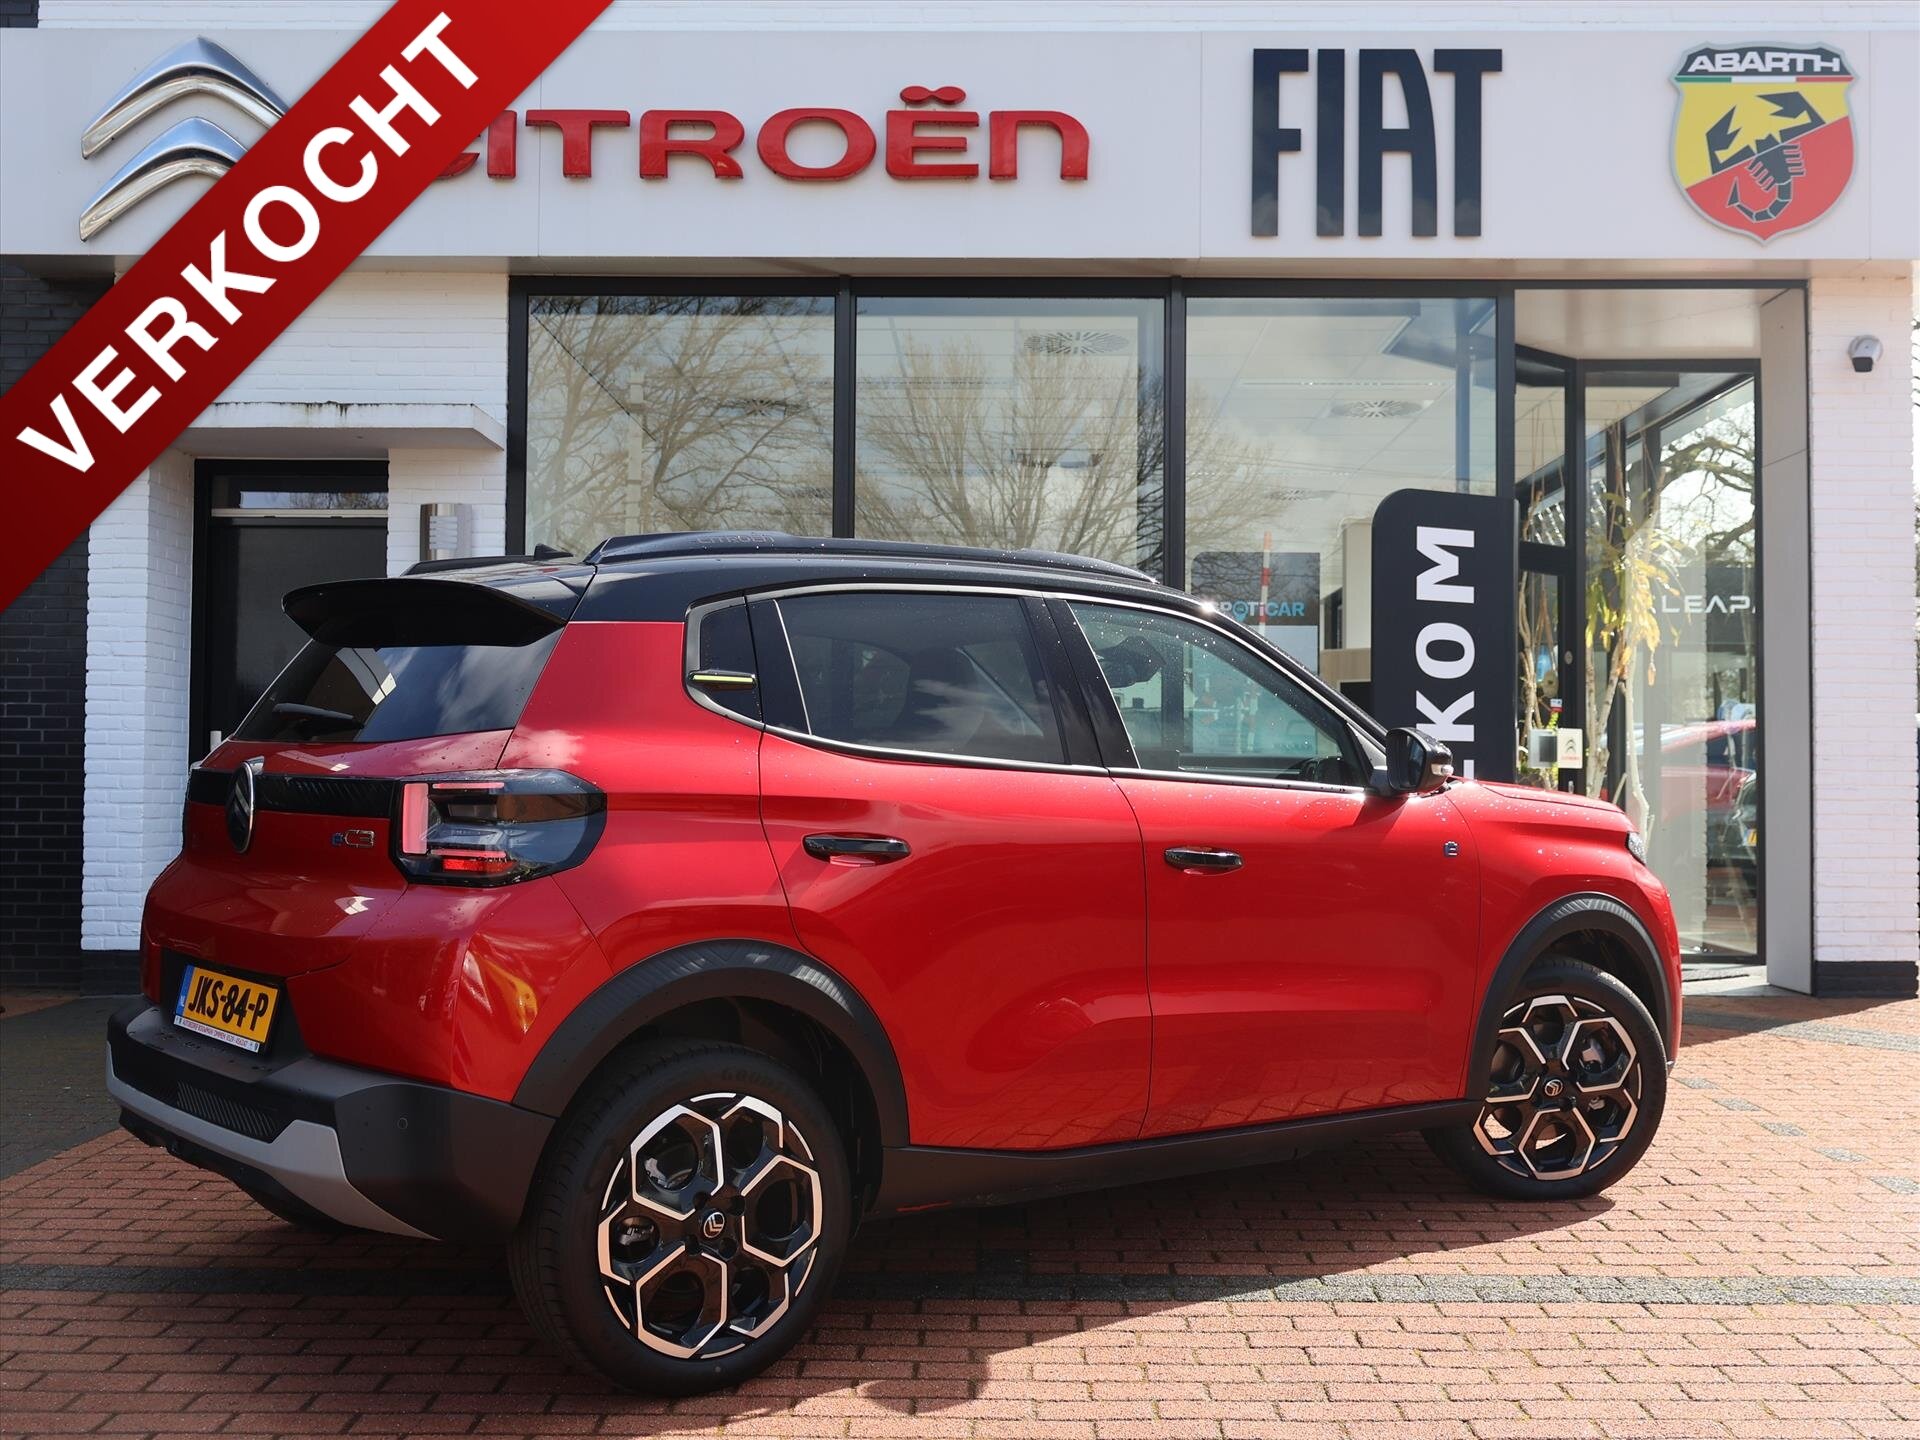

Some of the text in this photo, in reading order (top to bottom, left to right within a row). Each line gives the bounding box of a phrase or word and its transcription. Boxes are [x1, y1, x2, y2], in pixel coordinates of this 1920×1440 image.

[1686, 50, 1841, 73] ABARTH
[1251, 48, 1503, 237] FIAT
[1661, 594, 1756, 614] LEAP
[1415, 525, 1476, 781] KOM
[188, 975, 269, 1032] JKS-84-P
